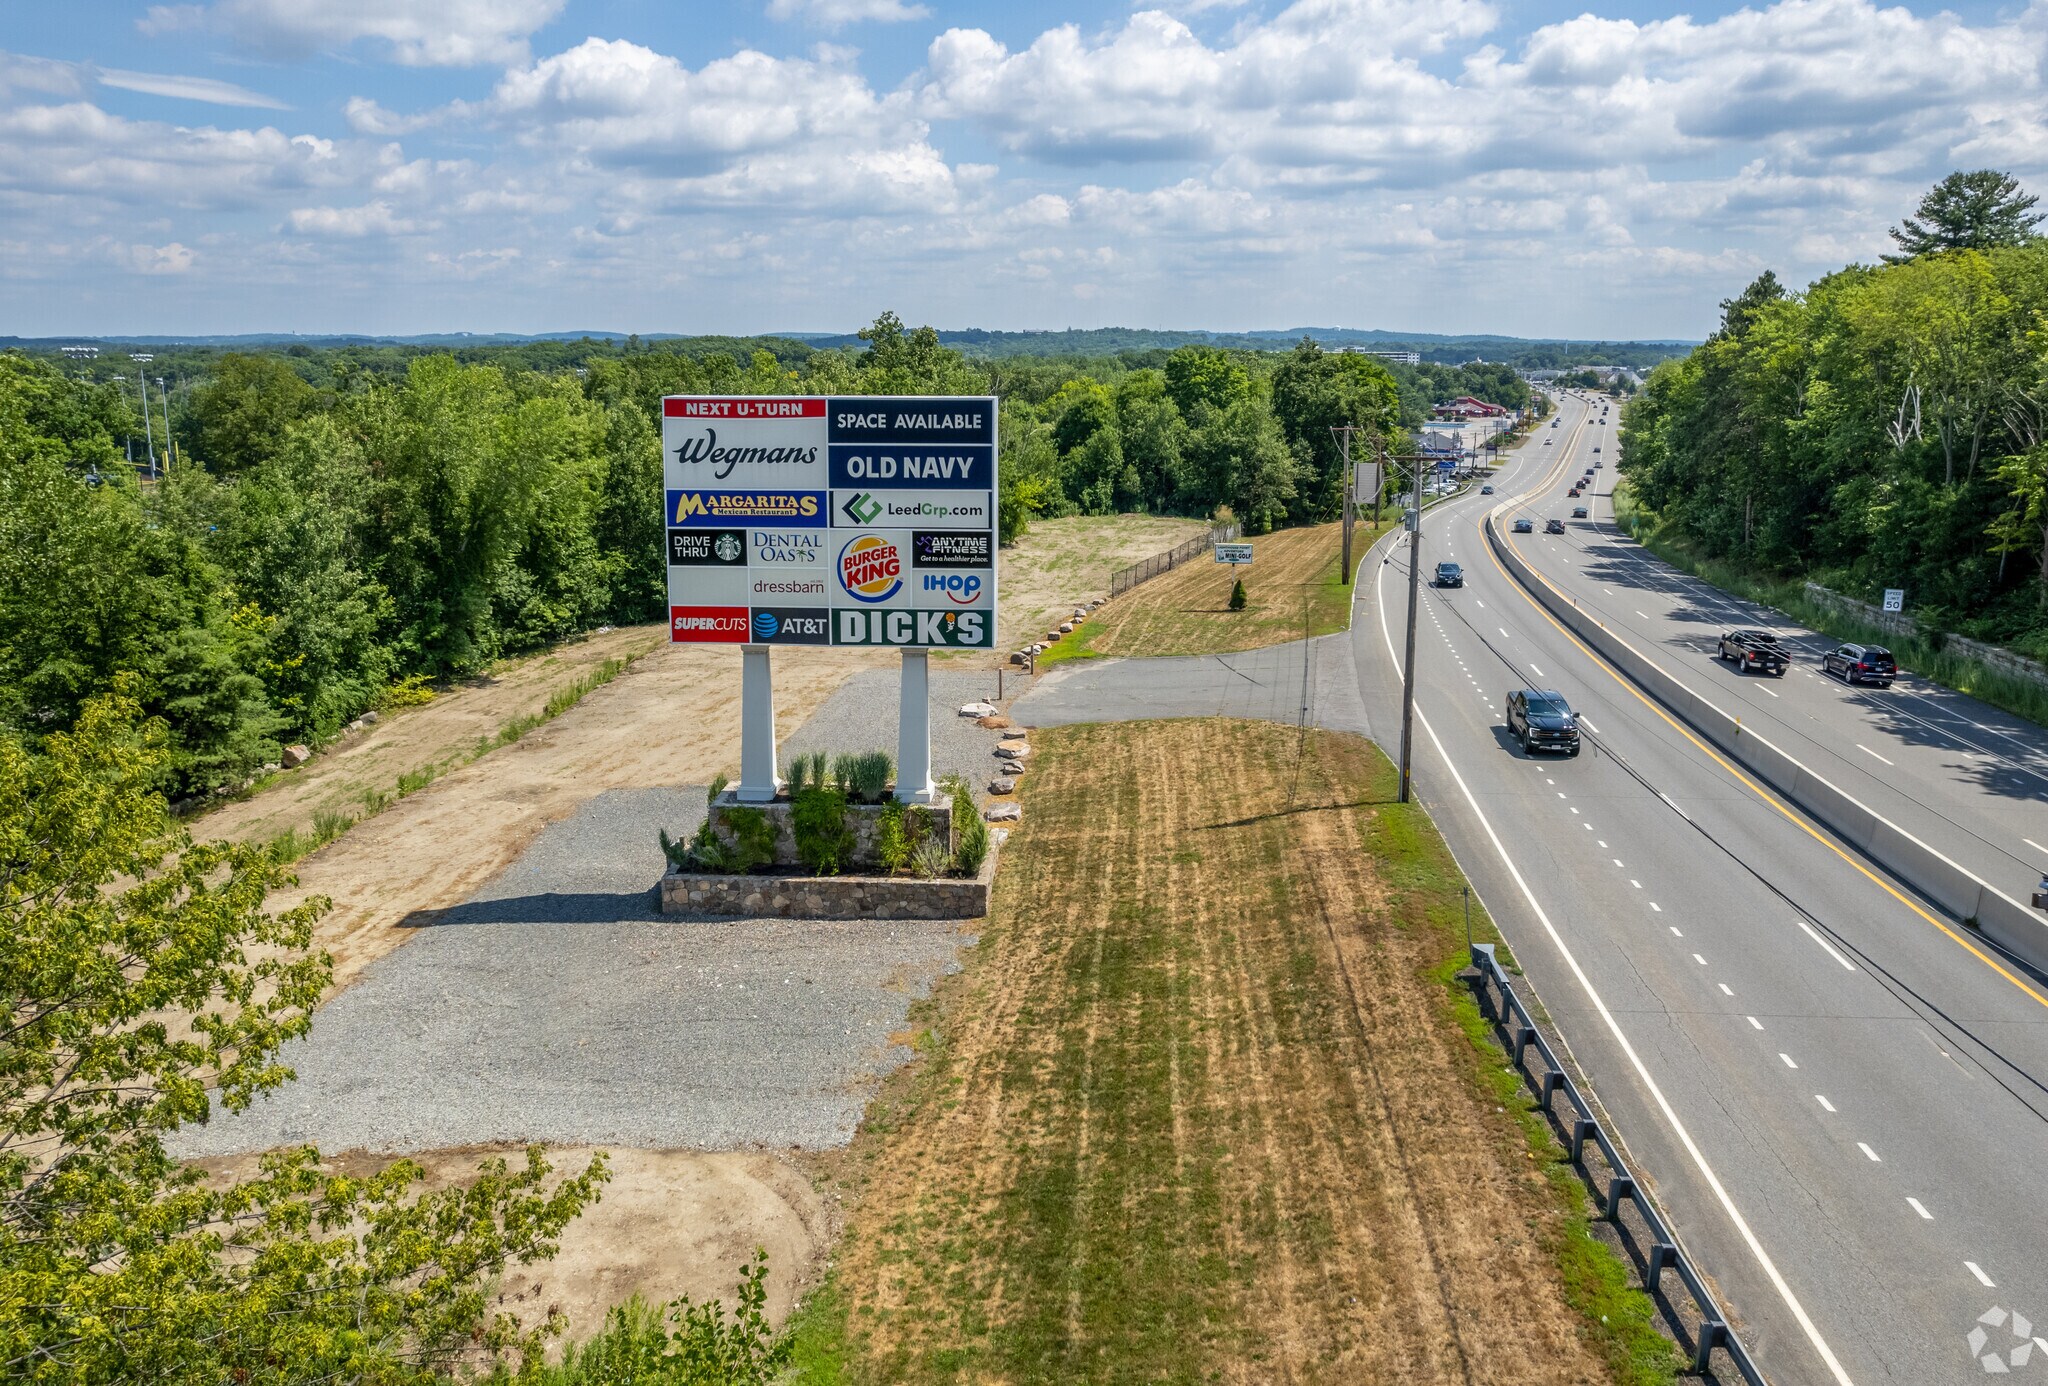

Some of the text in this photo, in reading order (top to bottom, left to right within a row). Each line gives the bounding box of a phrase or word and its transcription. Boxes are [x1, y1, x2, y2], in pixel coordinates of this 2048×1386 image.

[686, 403, 803, 416] NEXT U-TURN
[837, 414, 982, 429] SPACE AVAILABLE
[673, 428, 818, 480] Wegmans
[847, 456, 974, 479] OLD NAVY
[676, 493, 818, 524] MARGARITAS
[750, 508, 793, 516] Restaurant
[888, 503, 983, 518] LeedGrp.com
[674, 536, 711, 547] DRIVE
[754, 532, 822, 547] DENTAL
[931, 537, 987, 547] ANYTIME
[674, 547, 709, 558] THRU
[932, 546, 987, 554] FITNESS
[844, 545, 897, 572] BURGER
[846, 558, 900, 590] KING
[754, 580, 824, 593] dressbarn
[674, 617, 747, 631] SUPERCUTS
[781, 618, 828, 634] AT&T
[840, 611, 983, 645] DICK'S
